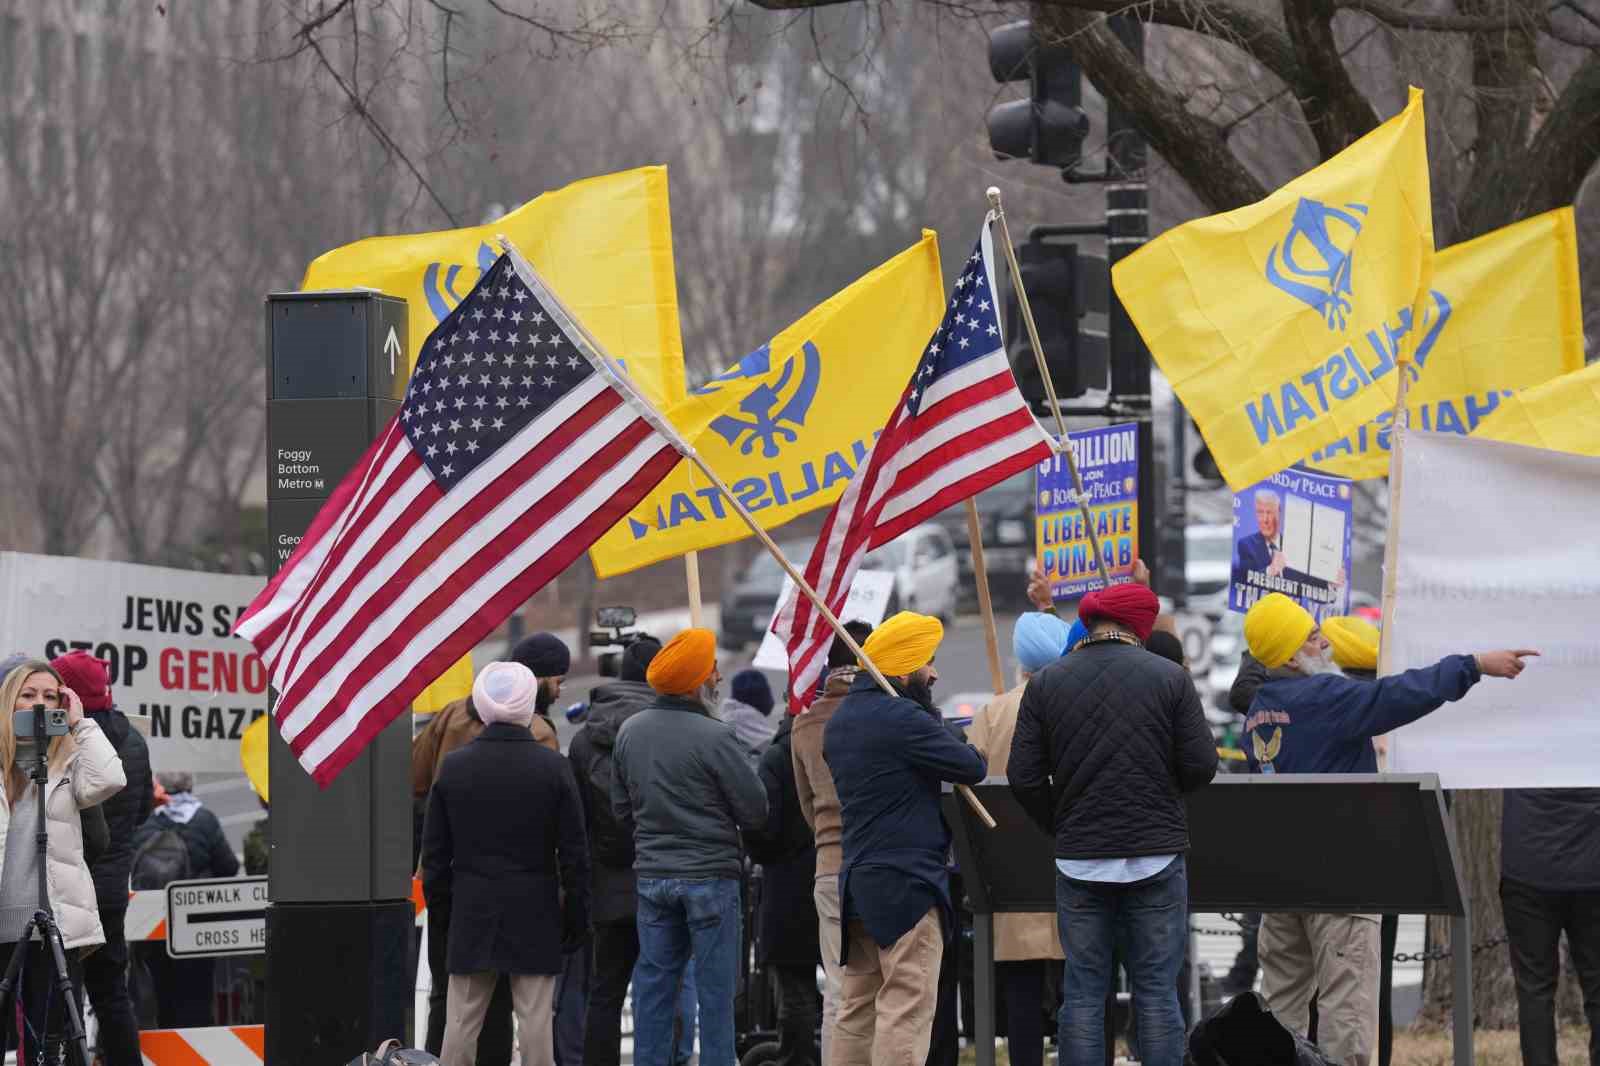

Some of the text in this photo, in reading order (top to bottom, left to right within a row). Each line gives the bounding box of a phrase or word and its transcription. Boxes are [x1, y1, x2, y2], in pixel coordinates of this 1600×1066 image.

[278, 449, 312, 461] Foggy
[278, 464, 320, 474] Bottom
[1084, 470, 1105, 481] JOIN
[278, 479, 313, 489] Metro
[1093, 481, 1121, 499] PEACE
[1302, 478, 1337, 498] PEACE
[1043, 507, 1132, 545] LIBEATE
[1247, 569, 1299, 594] PRESIDENT
[123, 597, 203, 636] JEWS
[182, 704, 264, 740] GAZ
[175, 888, 241, 906] SIDEWALK
[196, 930, 239, 946] CROSS
